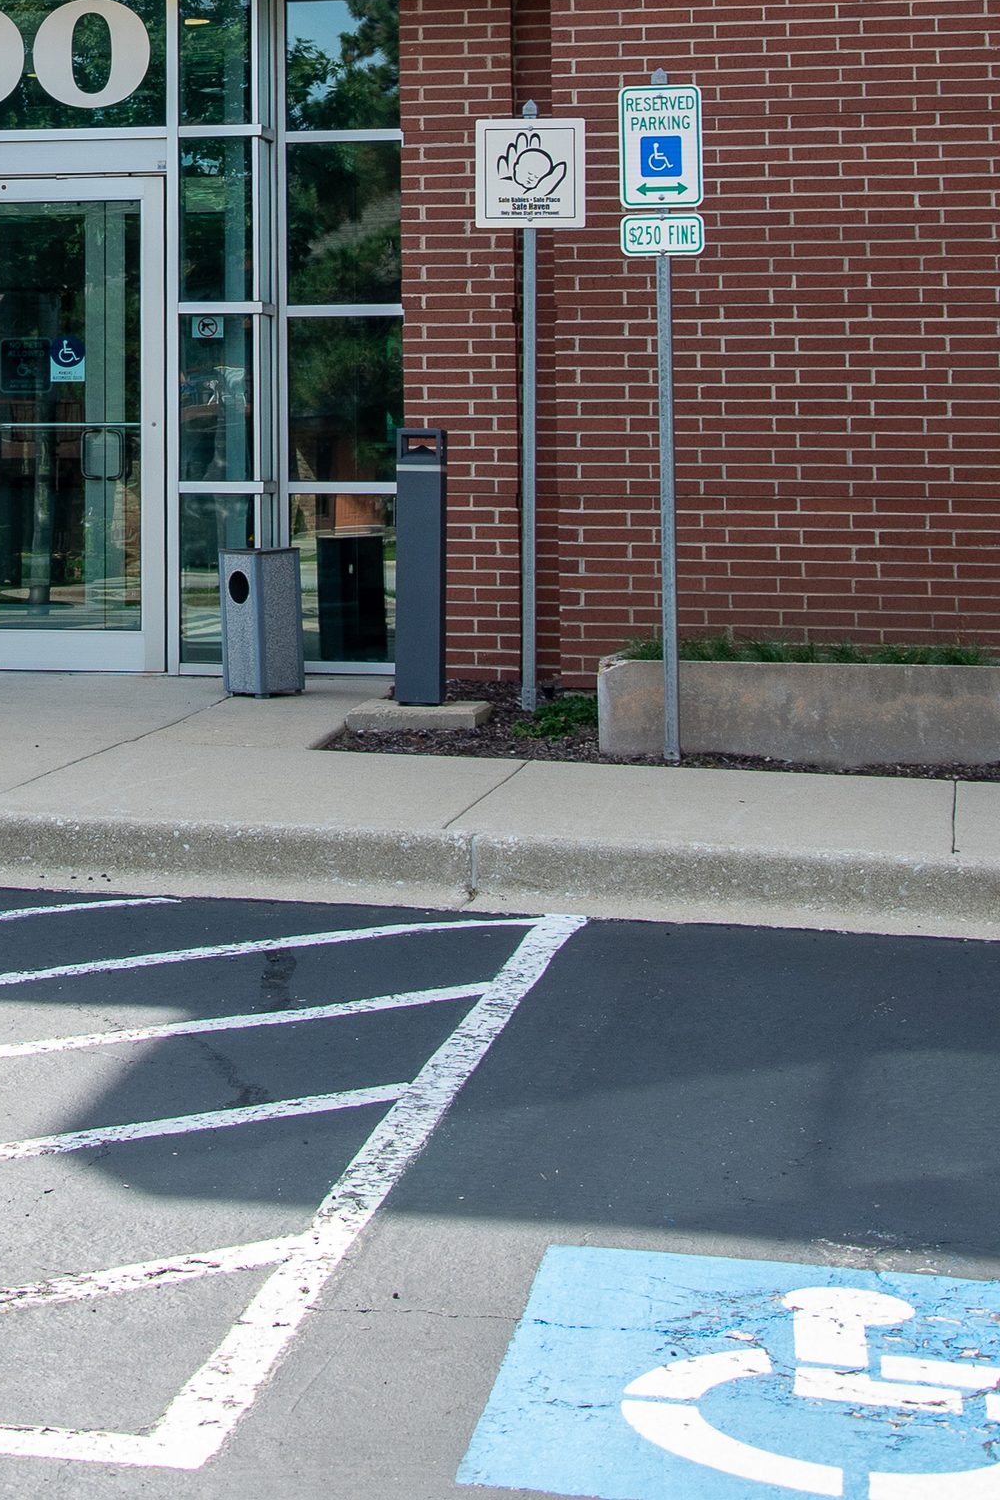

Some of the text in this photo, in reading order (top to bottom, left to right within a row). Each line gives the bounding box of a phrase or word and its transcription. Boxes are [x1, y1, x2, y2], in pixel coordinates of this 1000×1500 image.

[625, 95, 695, 113] RESERVED
[630, 115, 691, 132] PARKING
[512, 203, 550, 211] Safe Haven
[628, 224, 697, 246] $250 FINE
